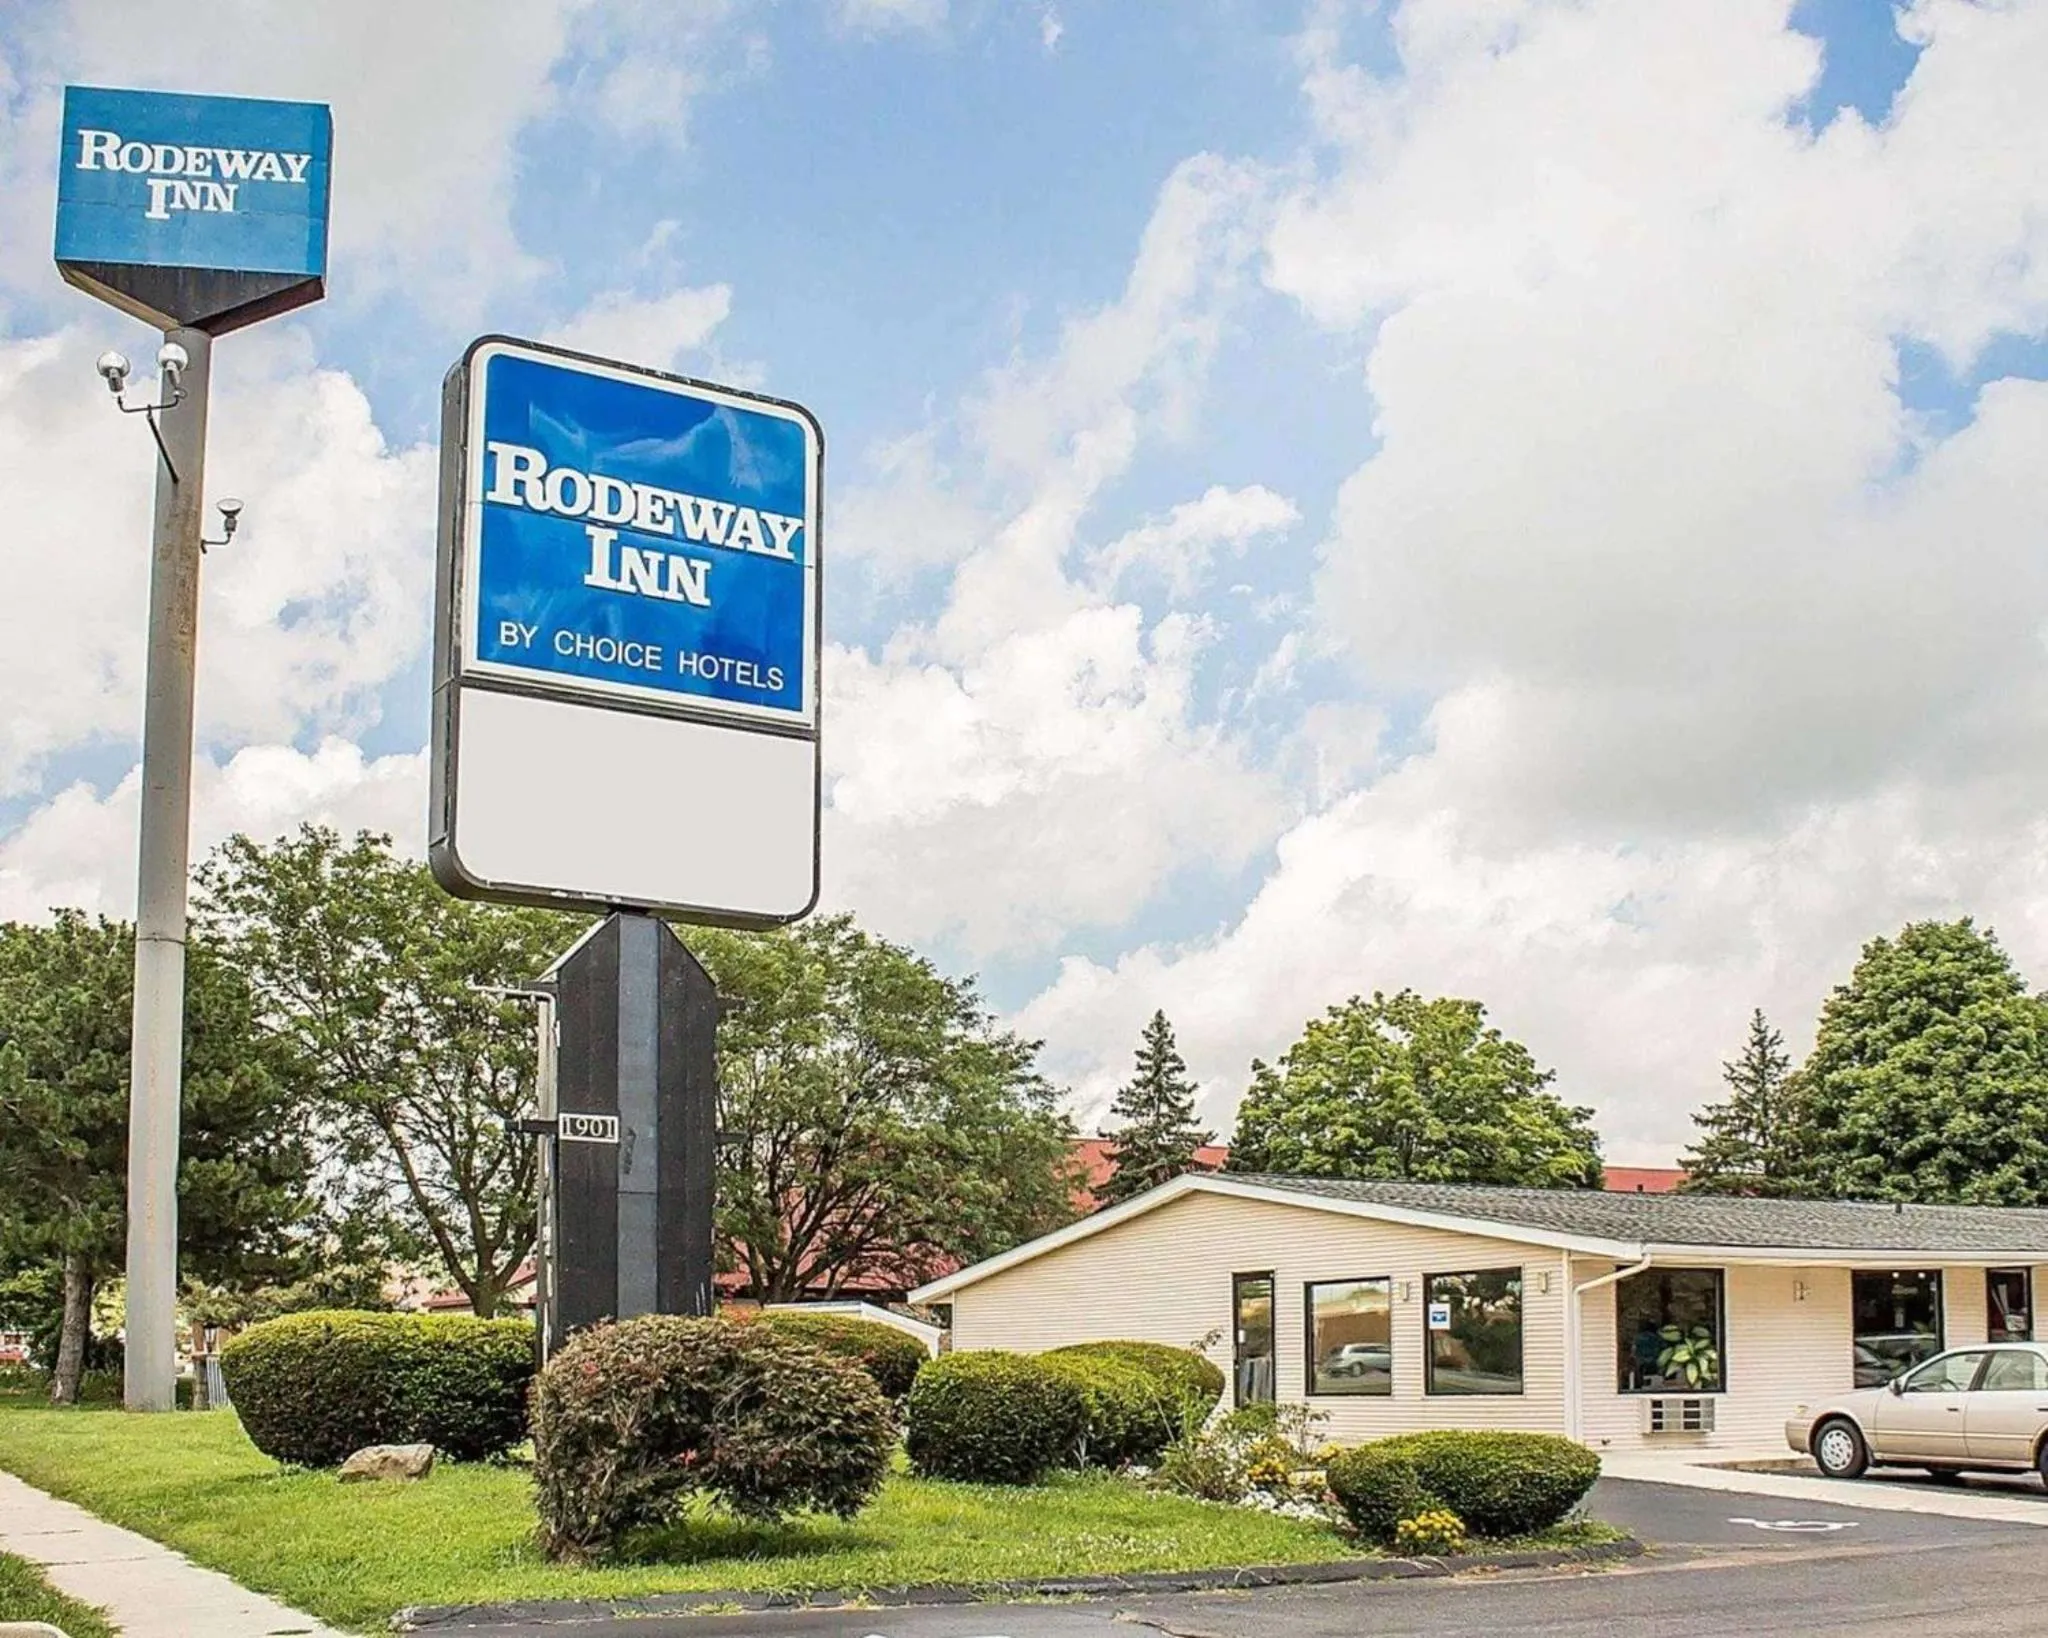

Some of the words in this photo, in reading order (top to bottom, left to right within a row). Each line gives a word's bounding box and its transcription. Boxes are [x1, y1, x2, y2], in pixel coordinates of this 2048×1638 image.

[76, 129, 311, 183] RODEWAY
[145, 178, 239, 219] INN
[486, 441, 804, 561] RODEWAY
[584, 525, 711, 607] INN
[500, 621, 538, 649] BY
[554, 631, 663, 671] CHOICE
[679, 651, 785, 691] HOTELS
[564, 1117, 615, 1137] 1901
